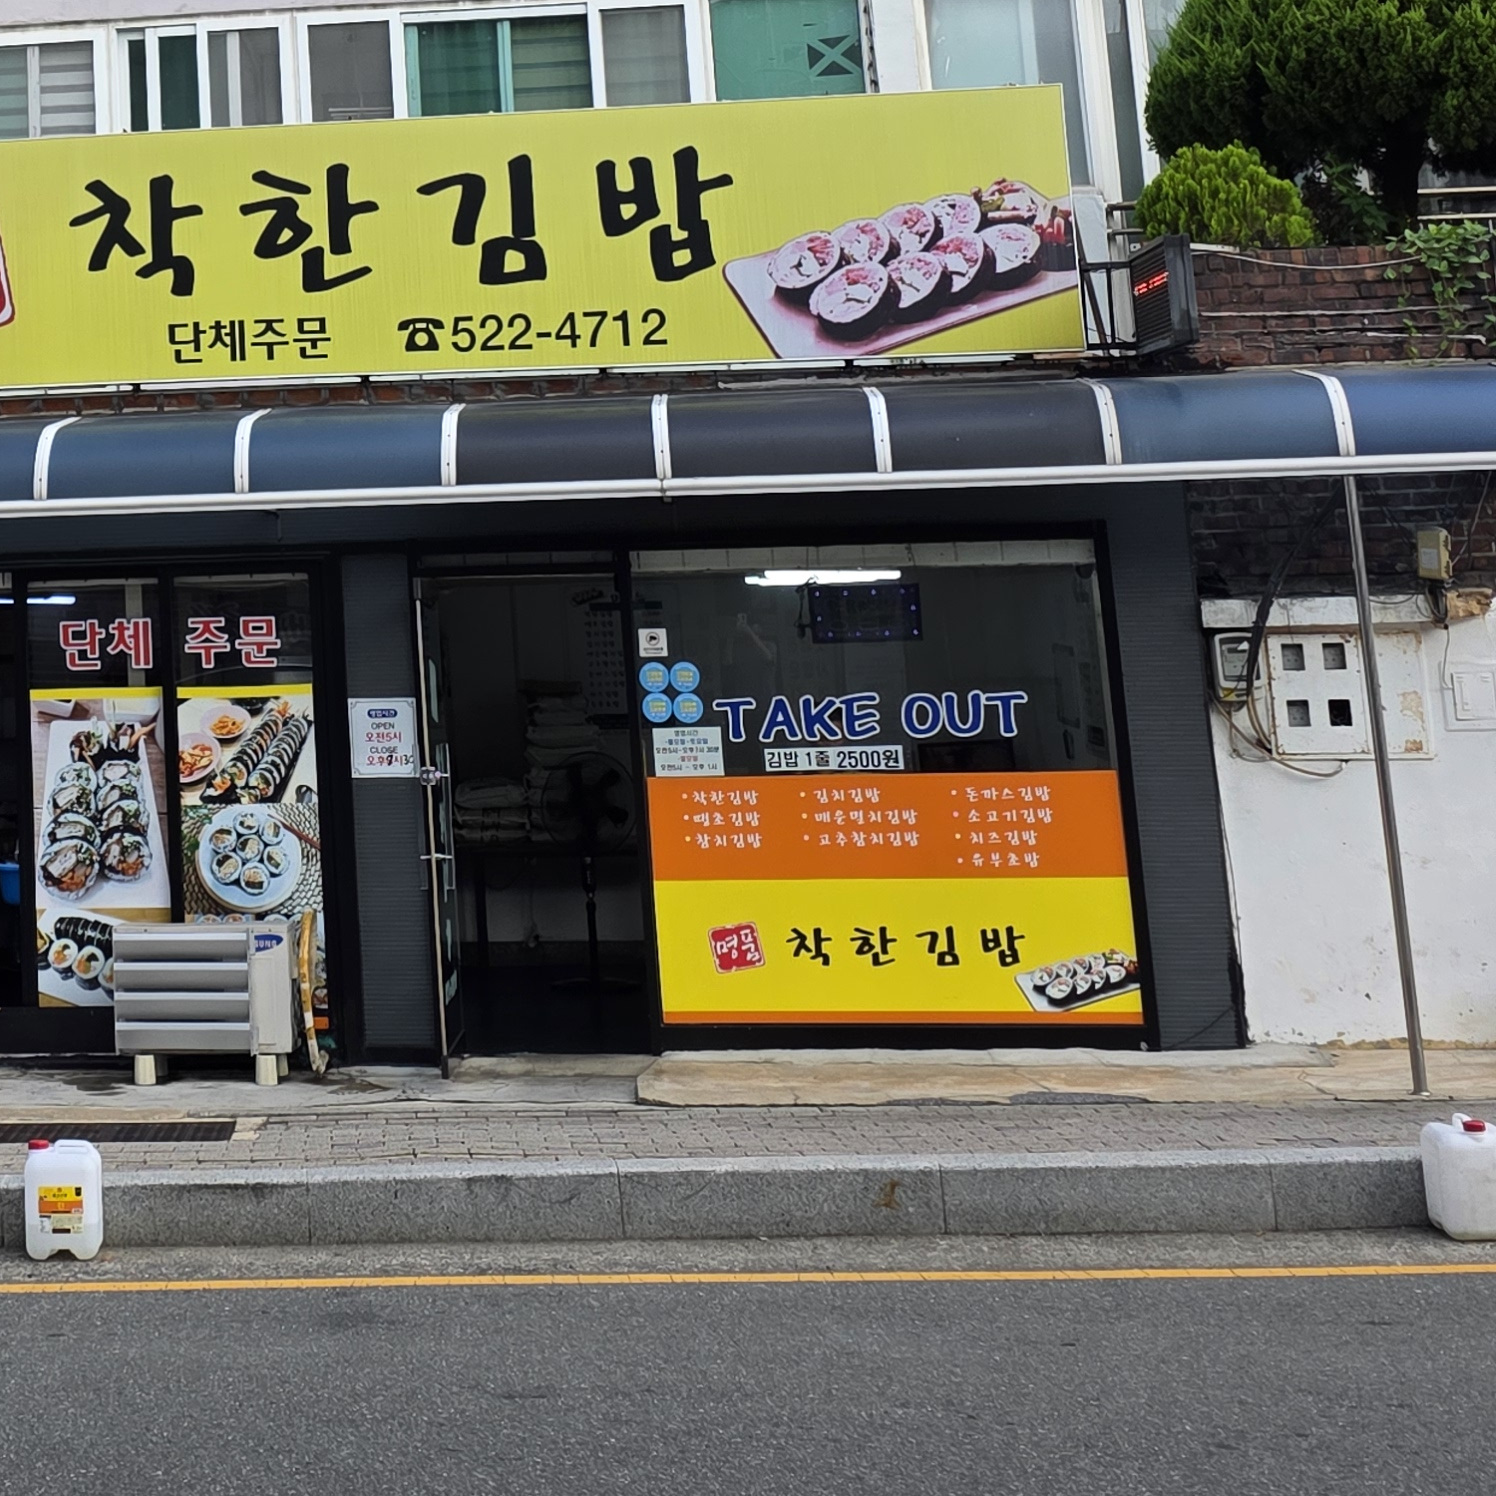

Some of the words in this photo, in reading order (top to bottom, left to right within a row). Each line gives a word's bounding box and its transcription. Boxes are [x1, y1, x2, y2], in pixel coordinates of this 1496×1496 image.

[167, 316, 332, 363] 단체주문
[449, 307, 669, 354] 522-4712
[59, 617, 154, 671] 단체
[184, 615, 281, 669] 주문
[712, 692, 881, 743] TAKE
[901, 689, 1029, 739] OUT
[371, 722, 395, 730] OPEN
[365, 731, 402, 744] 오전5시
[369, 746, 399, 754] CLOSE
[766, 750, 799, 769] 김밥
[837, 748, 901, 770] 2500원
[692, 790, 759, 806] 착한김밥
[813, 787, 881, 804] 김치김밥
[965, 785, 1051, 802] 돈까스김밥
[693, 811, 761, 827] 땡초김밥
[814, 809, 918, 825] 매운멸치김밥
[967, 807, 1053, 824] 소고기김밥
[695, 833, 762, 849] 참치김밥
[818, 830, 920, 847] 고추참치김밥
[969, 830, 1038, 846] 치즈김밥
[971, 852, 1040, 868] 유부초밥
[716, 928, 761, 964] 명품
